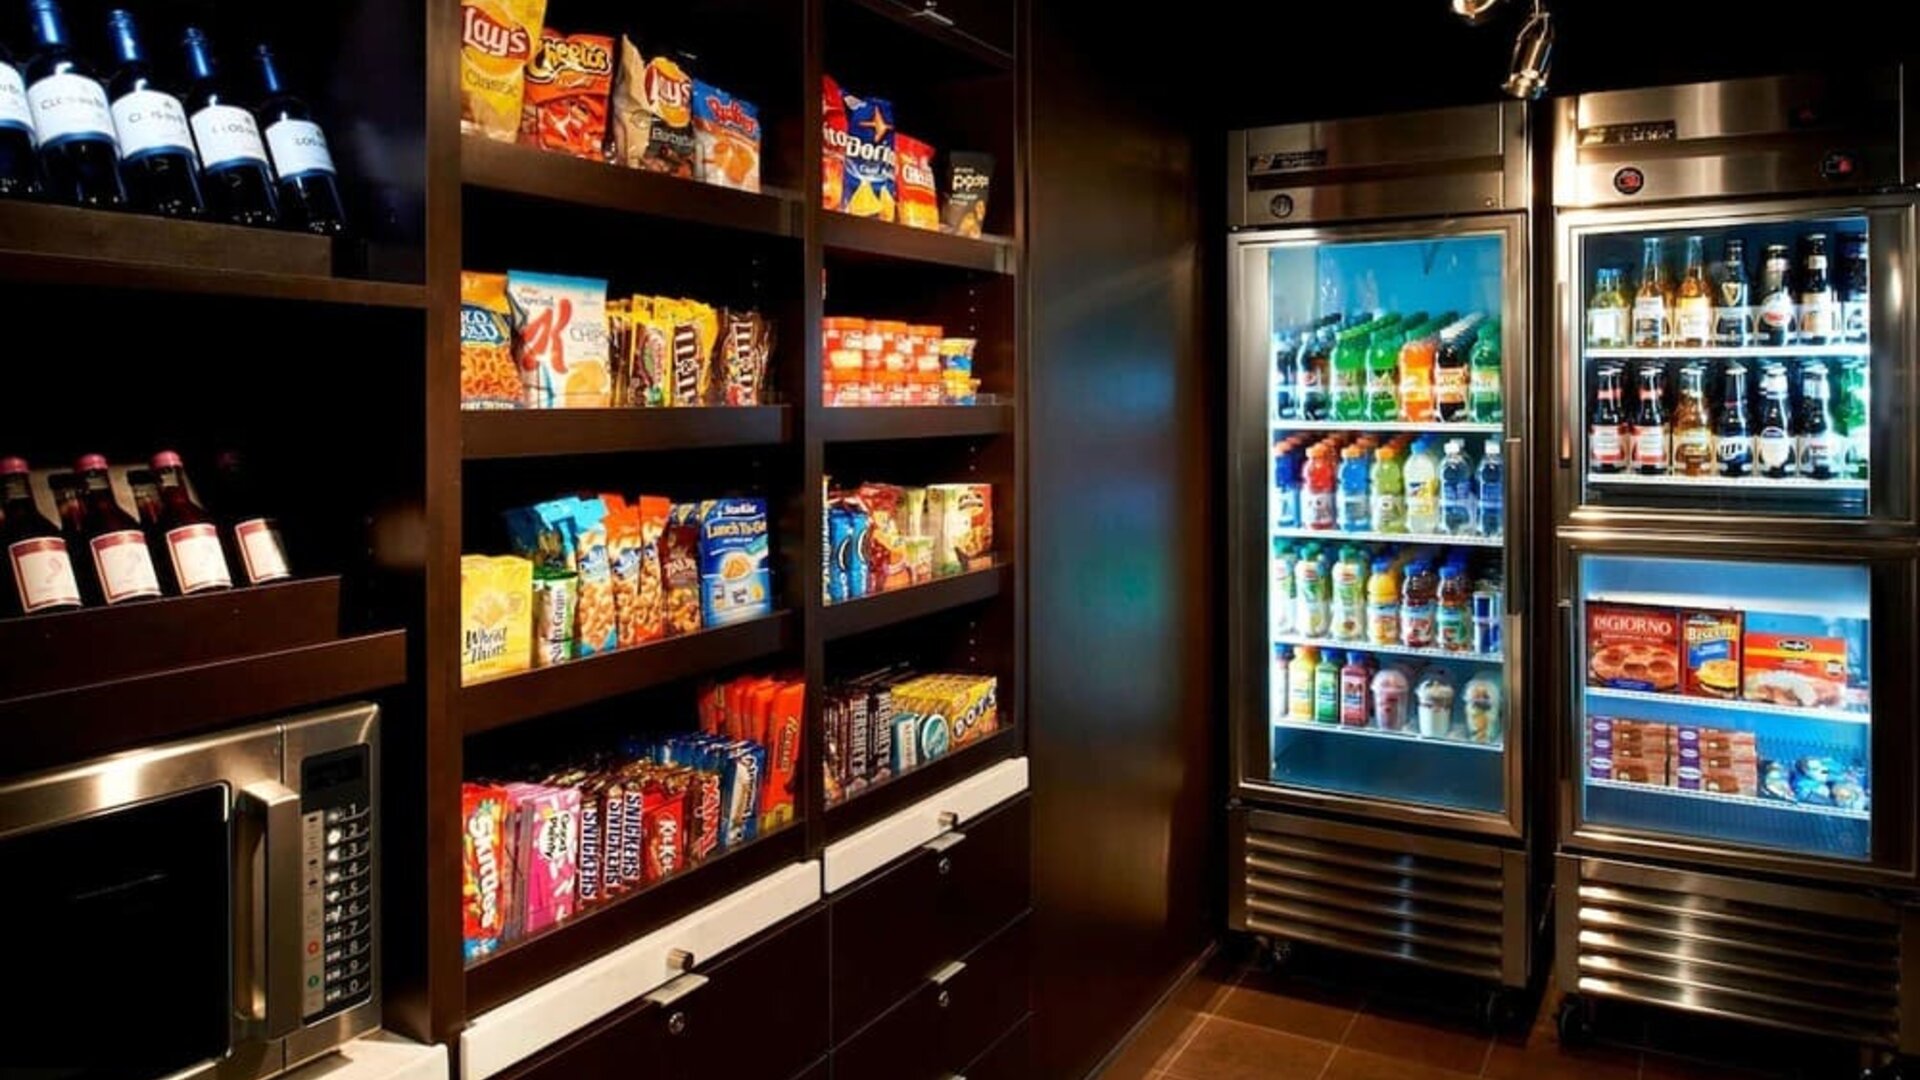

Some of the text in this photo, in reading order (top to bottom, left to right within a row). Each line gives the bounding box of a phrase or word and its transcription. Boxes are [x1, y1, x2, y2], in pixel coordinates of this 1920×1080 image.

[464, 7, 526, 56] Lay's
[526, 40, 607, 79] Cheetos
[520, 299, 572, 374] K
[707, 522, 741, 539] Lunch
[465, 627, 508, 650] Wheat
[624, 791, 641, 879] SNICKERS
[468, 812, 498, 929] Skittles
